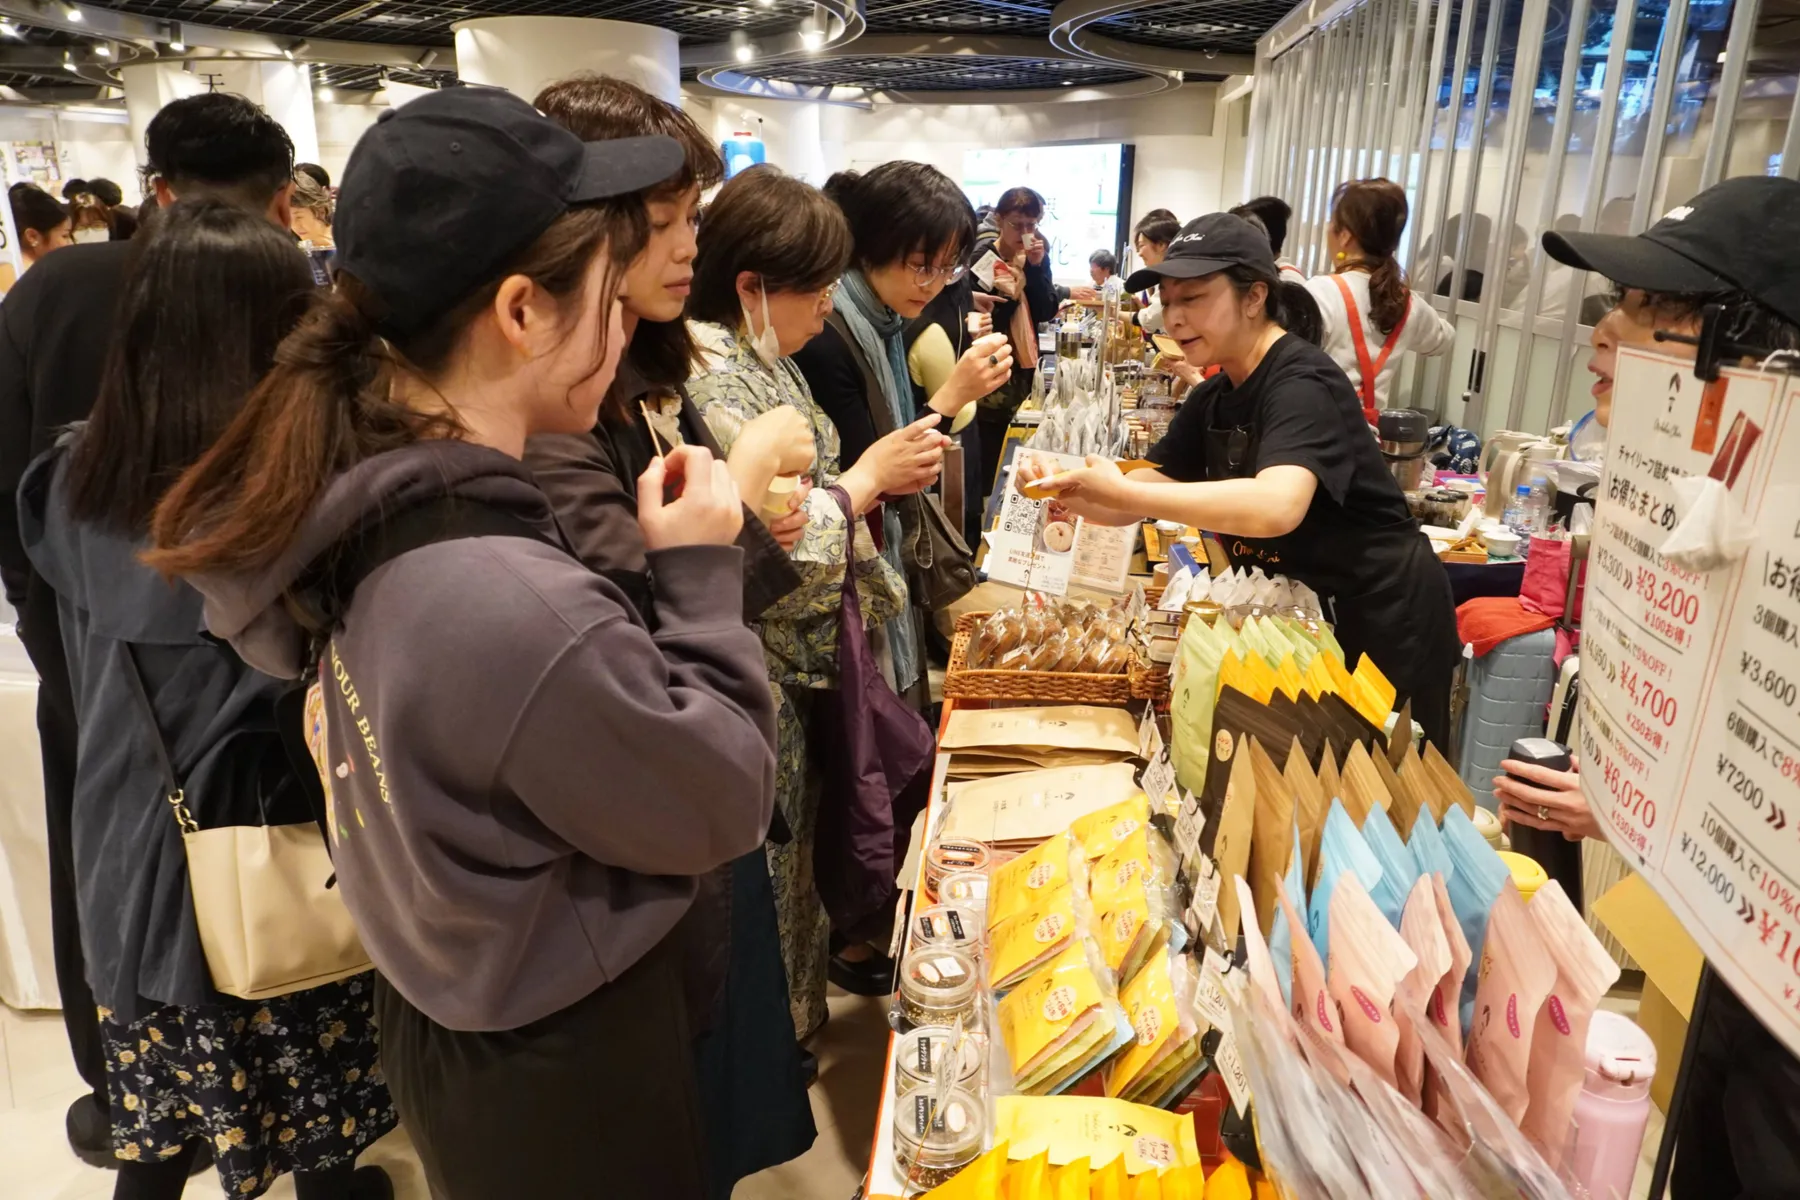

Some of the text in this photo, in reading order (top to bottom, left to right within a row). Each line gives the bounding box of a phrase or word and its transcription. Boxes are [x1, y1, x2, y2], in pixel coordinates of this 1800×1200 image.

[1619, 445, 1695, 484] チャイリーフ詰め
[1610, 474, 1679, 531] お得なまとめ
[1637, 565, 1699, 625] ¥3,200
[1620, 660, 1677, 727] ¥4,700
[1741, 650, 1797, 707] ¥3,600
[1604, 755, 1656, 829] ¥6,070
[1716, 752, 1764, 810] ¥7200
[1680, 832, 1735, 904] ¥12,000
